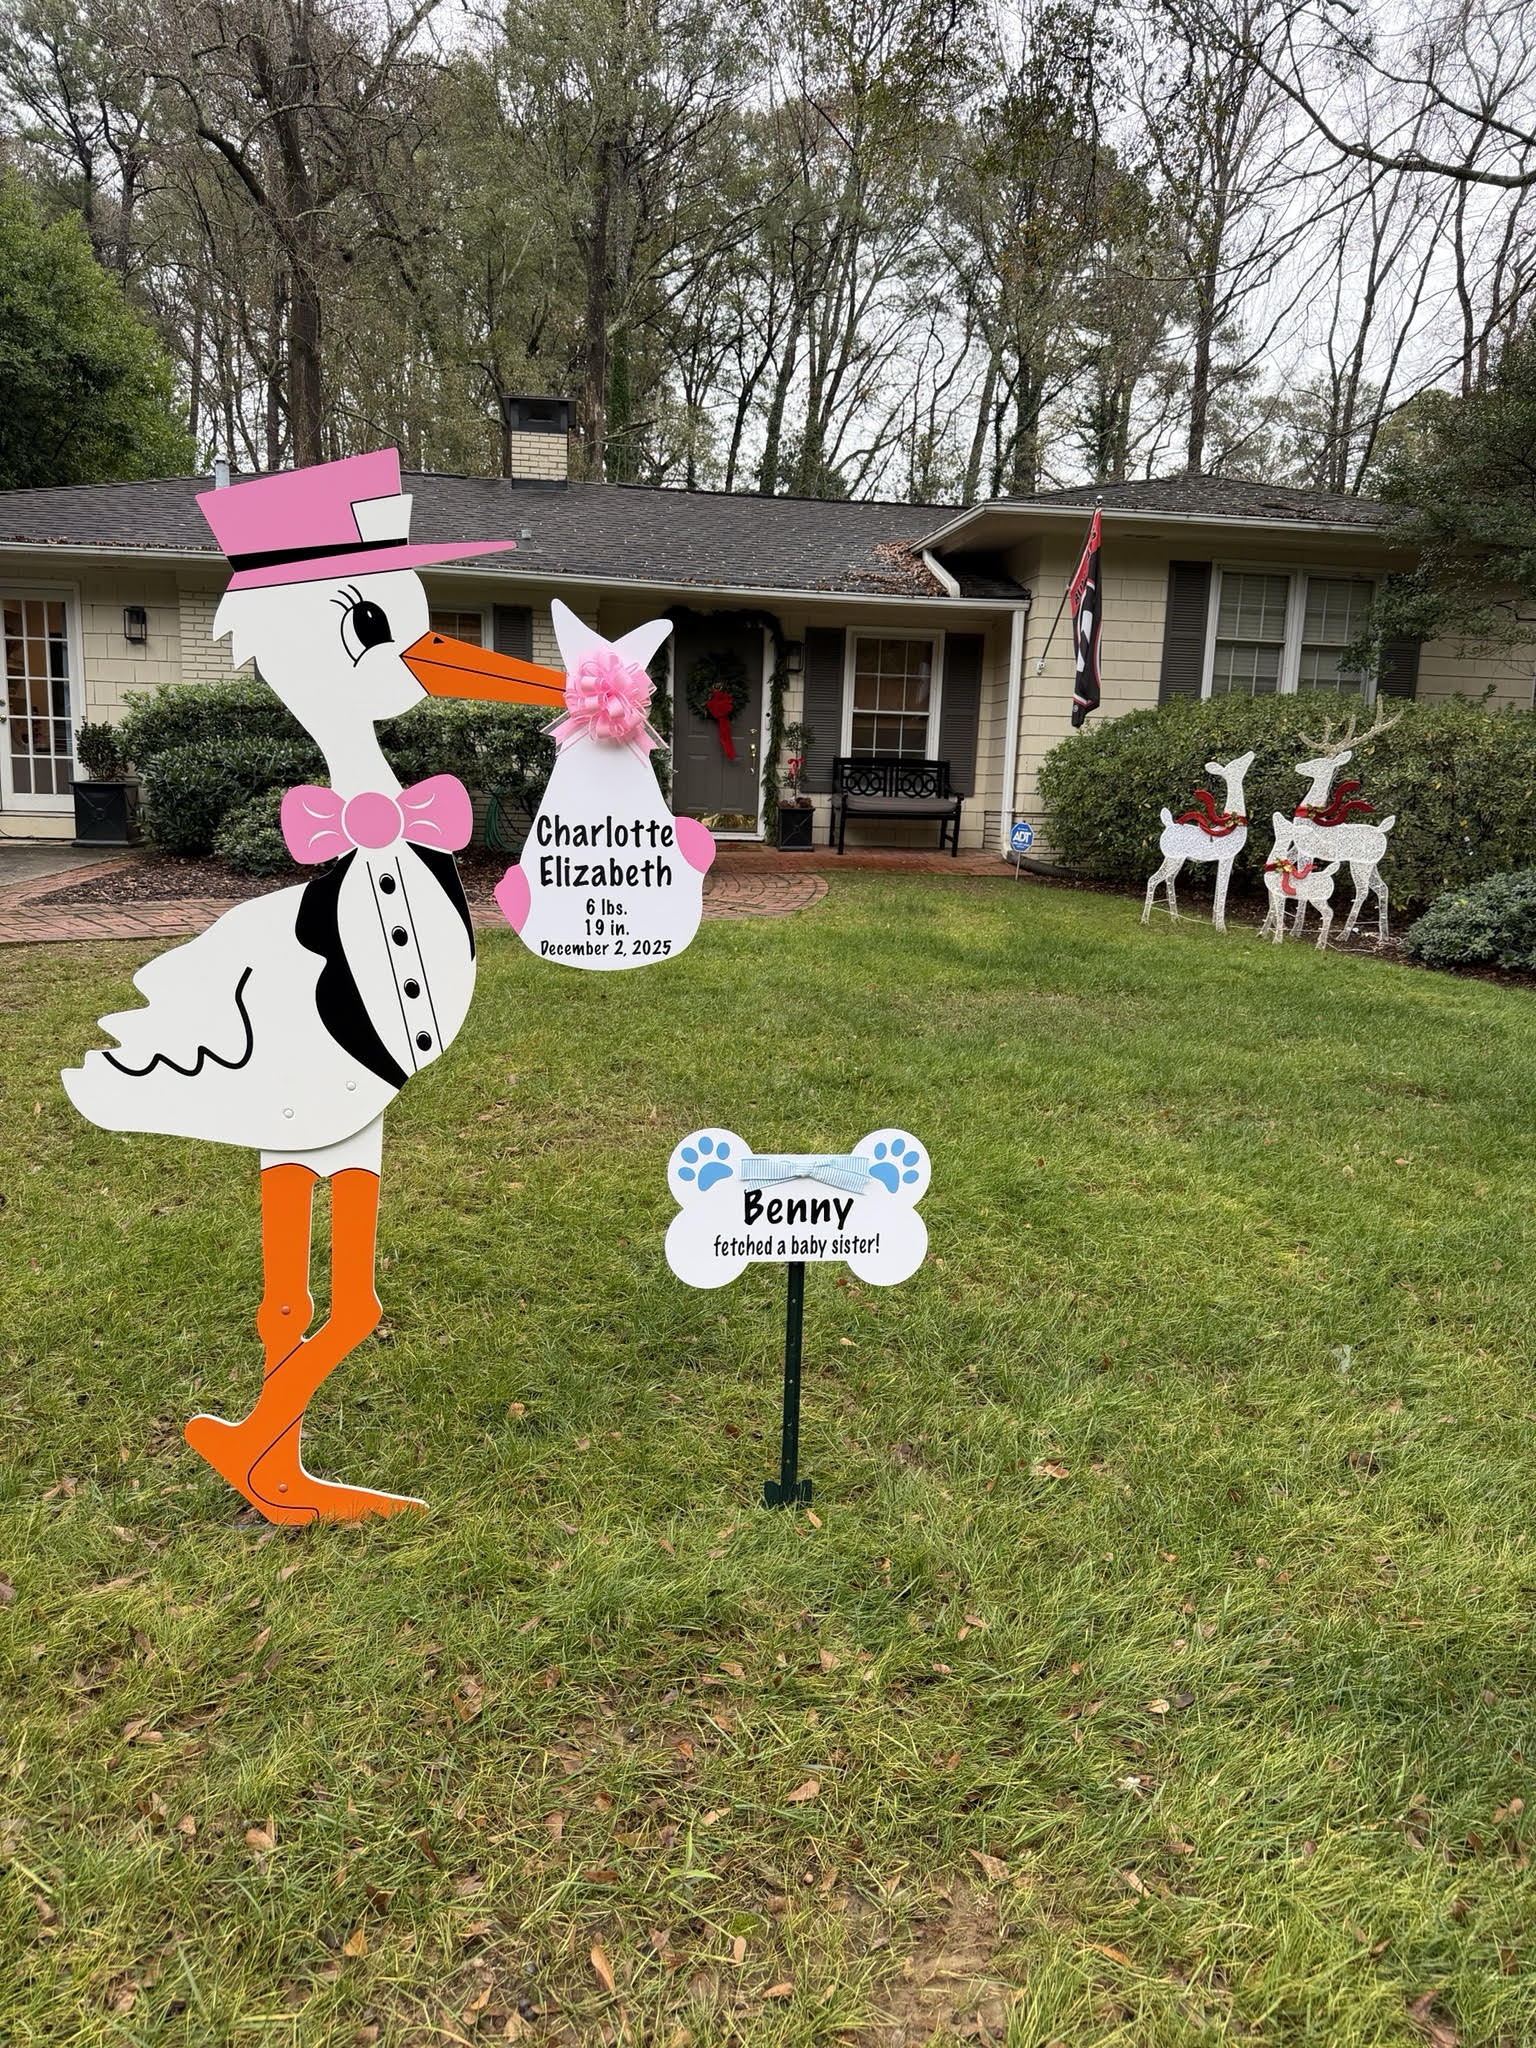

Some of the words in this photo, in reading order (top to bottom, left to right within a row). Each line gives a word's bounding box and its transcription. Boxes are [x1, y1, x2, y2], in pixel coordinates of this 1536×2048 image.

[537, 815, 674, 848] Charlotte
[1012, 831, 1032, 843] ADT
[540, 855, 672, 887] Elizabeth
[586, 898, 596, 915] 6
[602, 899, 628, 915] lbs.
[585, 919, 605, 936] 19
[610, 919, 630, 936] in.
[540, 940, 610, 956] December
[614, 940, 627, 957] 2,
[632, 940, 673, 956] 2025
[744, 1189, 854, 1231] Benny
[713, 1234, 773, 1257] fetched
[776, 1240, 787, 1256] a
[791, 1234, 828, 1259] baby
[831, 1232, 881, 1255] sister!
